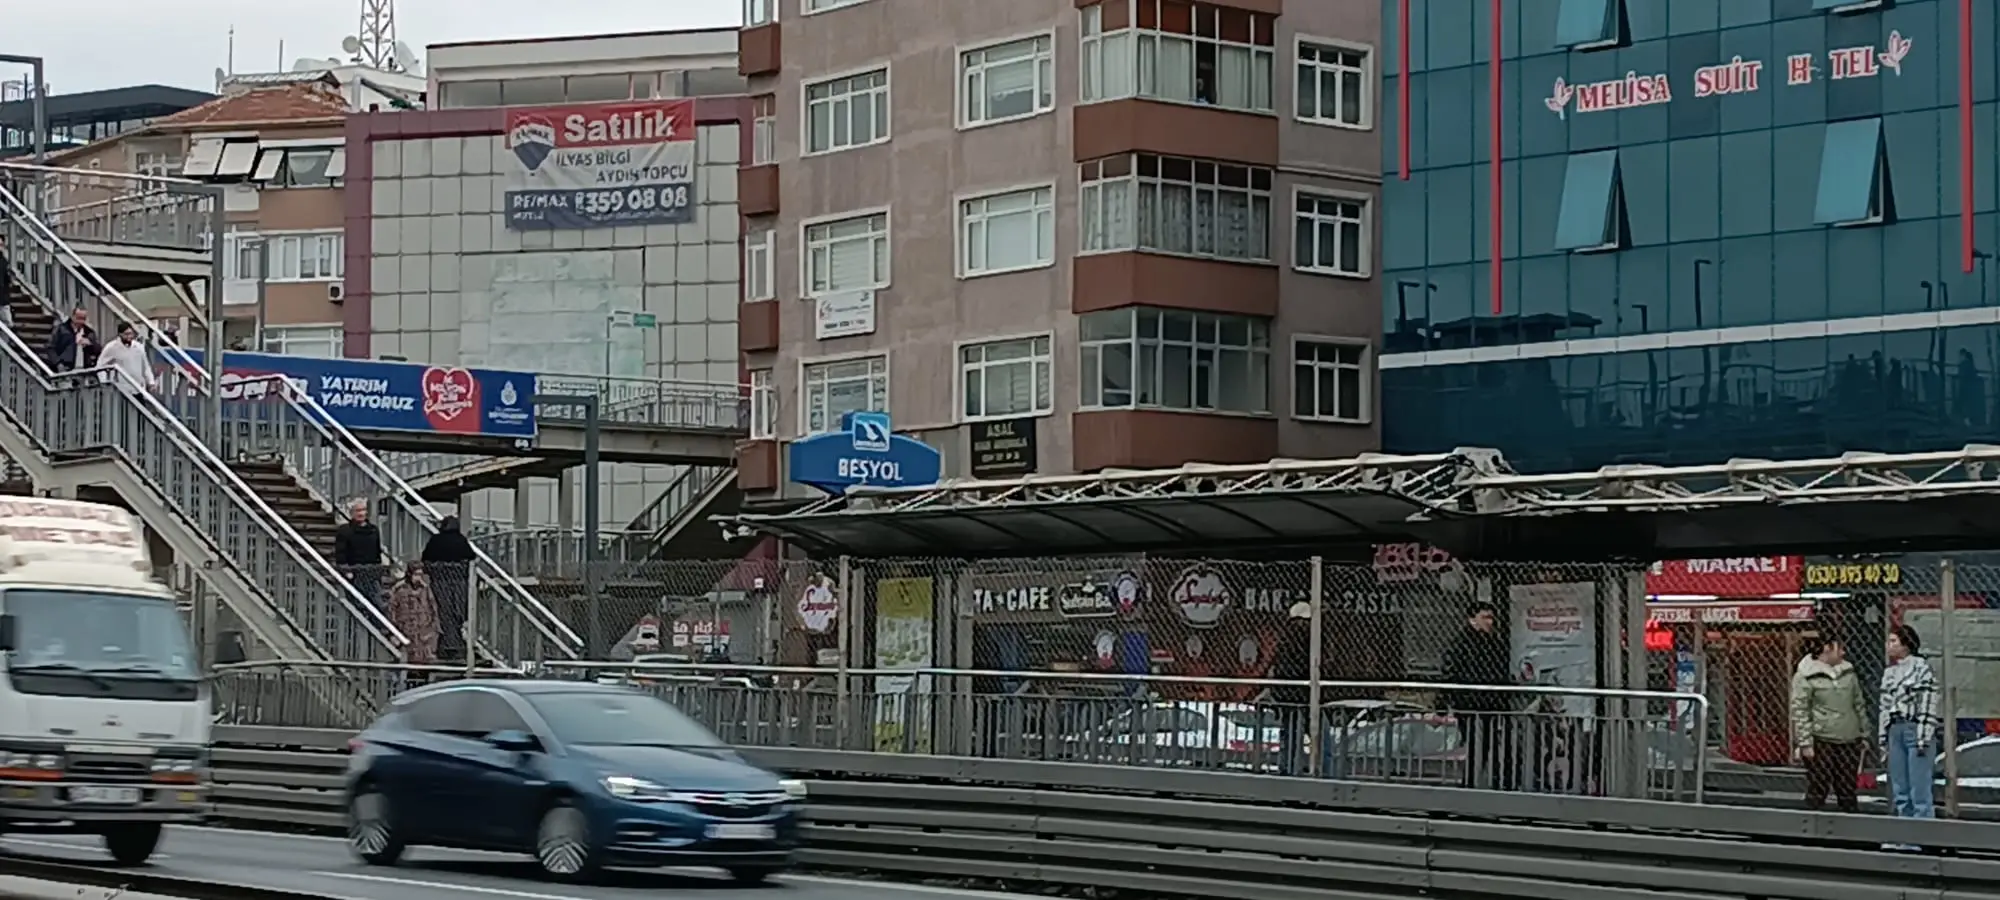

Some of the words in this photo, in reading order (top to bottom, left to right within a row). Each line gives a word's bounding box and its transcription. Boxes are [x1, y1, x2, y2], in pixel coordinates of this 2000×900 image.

[1576, 71, 1671, 112] MELİSA
[1694, 55, 1762, 97] SUİT
[563, 108, 675, 143] Satılık
[556, 150, 593, 168] İLYAS
[596, 148, 631, 166] BİLGİ
[643, 163, 688, 181] TOPÇU
[585, 191, 625, 213] 359
[628, 187, 656, 210] 08
[660, 186, 689, 208] 08
[320, 375, 389, 394] YATIRIM
[320, 391, 415, 410] YAPIYORUZ
